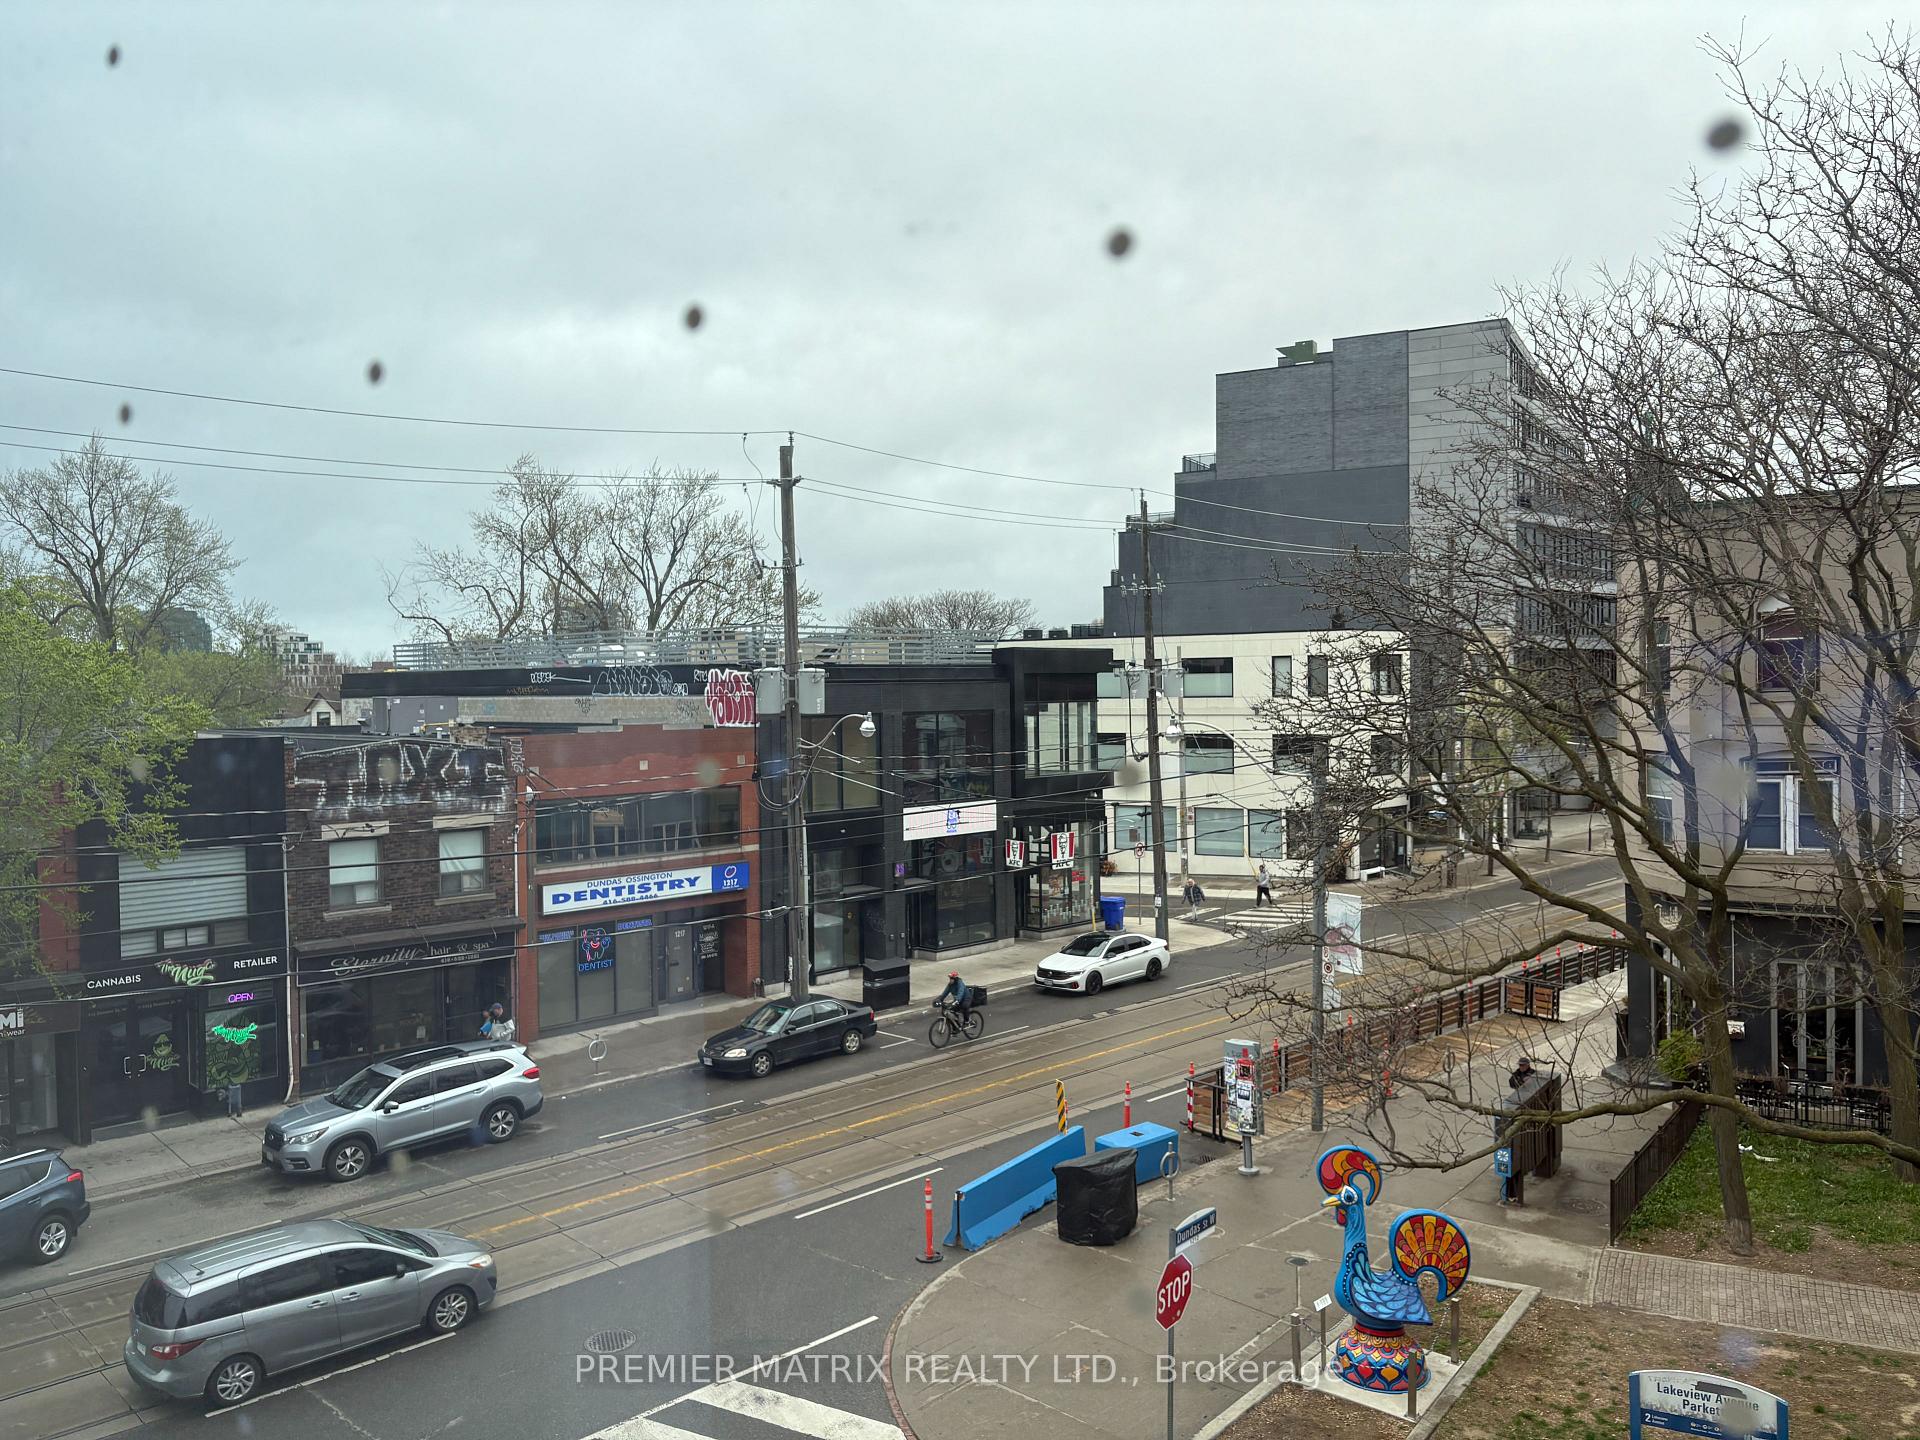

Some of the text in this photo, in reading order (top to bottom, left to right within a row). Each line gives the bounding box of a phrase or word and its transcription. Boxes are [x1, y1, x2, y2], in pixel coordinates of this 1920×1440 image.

[587, 872, 673, 889] DUNDAS OSSINGTON
[723, 879, 738, 887] 1217
[551, 876, 701, 905] DENTISTRY
[430, 946, 451, 956] hair
[472, 942, 489, 951] spa
[233, 956, 278, 969] RETAILER
[578, 960, 614, 972] DENTIST
[87, 974, 142, 989] CANNABIS
[227, 993, 254, 1003] OPEN
[1177, 1223, 1201, 1243] Dundas
[1202, 1219, 1208, 1229] St
[1210, 1213, 1216, 1225] W
[1158, 1271, 1190, 1314] STOP
[1657, 1382, 1711, 1402] Lakeview
[1645, 1413, 1651, 1423] 2
